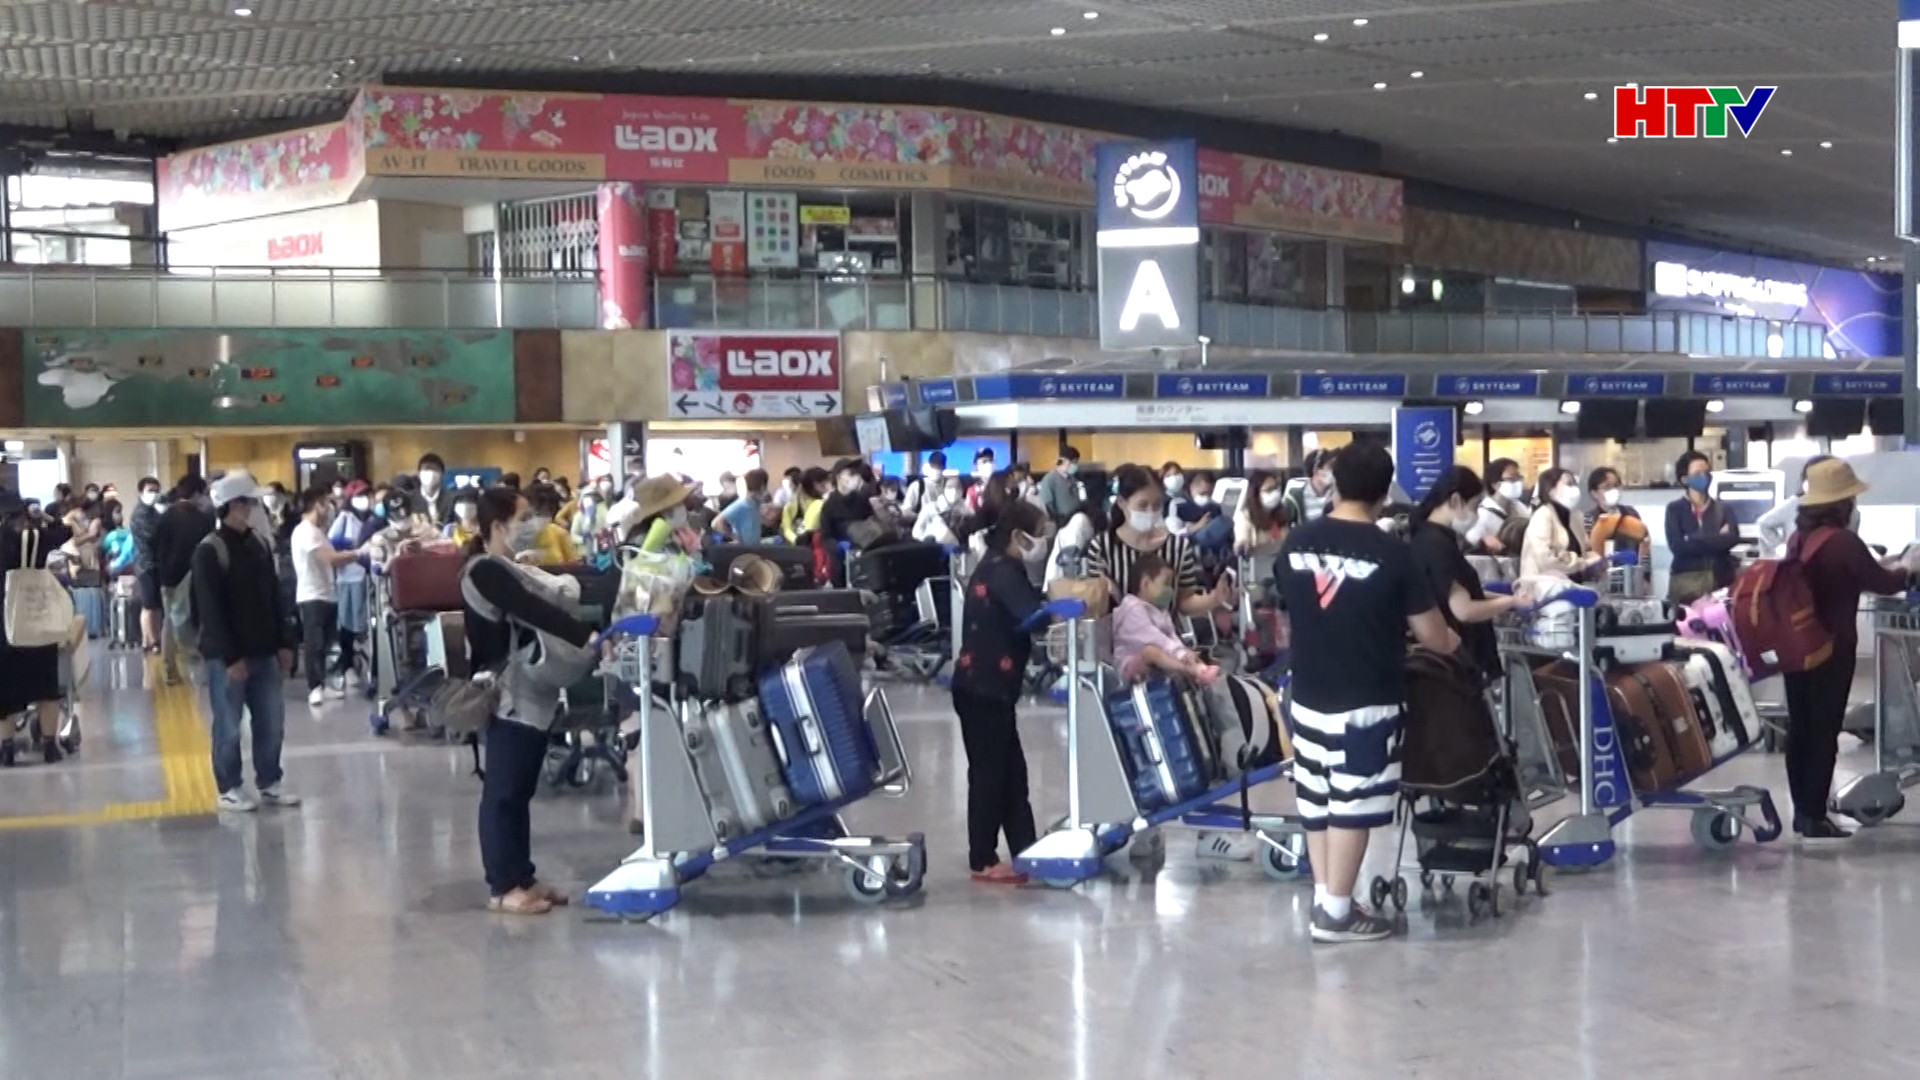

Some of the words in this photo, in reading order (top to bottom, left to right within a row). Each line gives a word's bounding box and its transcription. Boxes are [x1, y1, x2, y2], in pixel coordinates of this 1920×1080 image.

[456, 157, 522, 172] TRAVEL
[526, 158, 587, 173] GOODS
[763, 165, 816, 180] FOODS
[839, 167, 928, 182] COSMETICS
[1119, 260, 1180, 331] A
[1060, 383, 1115, 392] SKYTEAM
[1197, 382, 1249, 391] SKYTEAM
[1338, 382, 1388, 391] SKYTEAM
[1473, 382, 1521, 391] SKYTEAM
[1601, 382, 1649, 390] SKYTEAM
[1593, 726, 1616, 805] DHC
